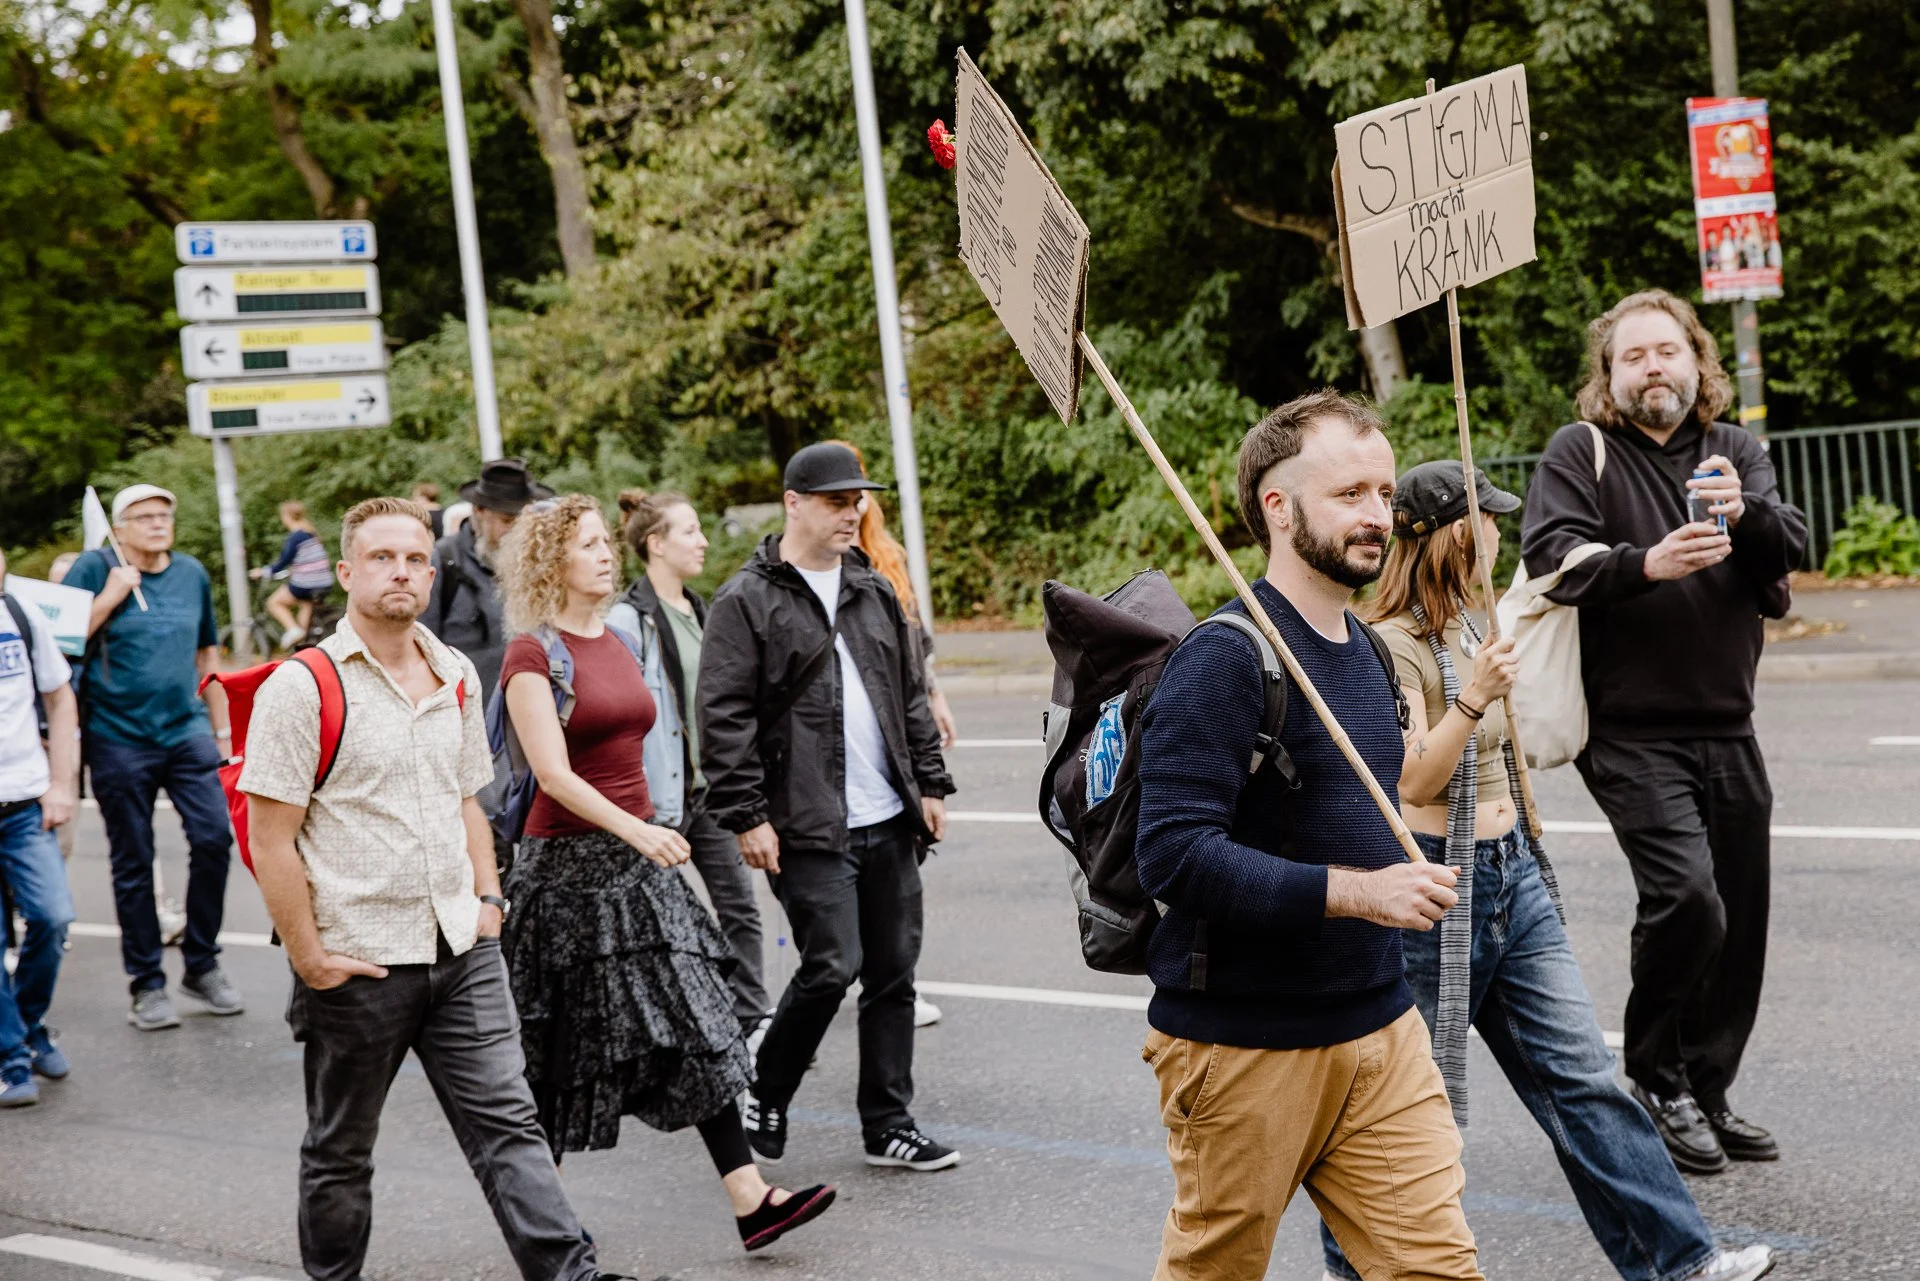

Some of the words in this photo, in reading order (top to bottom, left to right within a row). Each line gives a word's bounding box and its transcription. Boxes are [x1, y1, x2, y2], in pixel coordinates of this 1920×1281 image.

[965, 87, 1009, 216] MENSCHEN
[1358, 80, 1531, 215] STIGMA
[967, 181, 1001, 256] DEN
[1001, 225, 1017, 267] UND
[1408, 182, 1466, 232] macht
[968, 217, 1002, 306] SEHT
[1033, 189, 1077, 334] ERKRANKUNG
[1394, 209, 1503, 310] KRANK
[1028, 327, 1067, 417] NICHT
[1034, 302, 1066, 366] DIE
